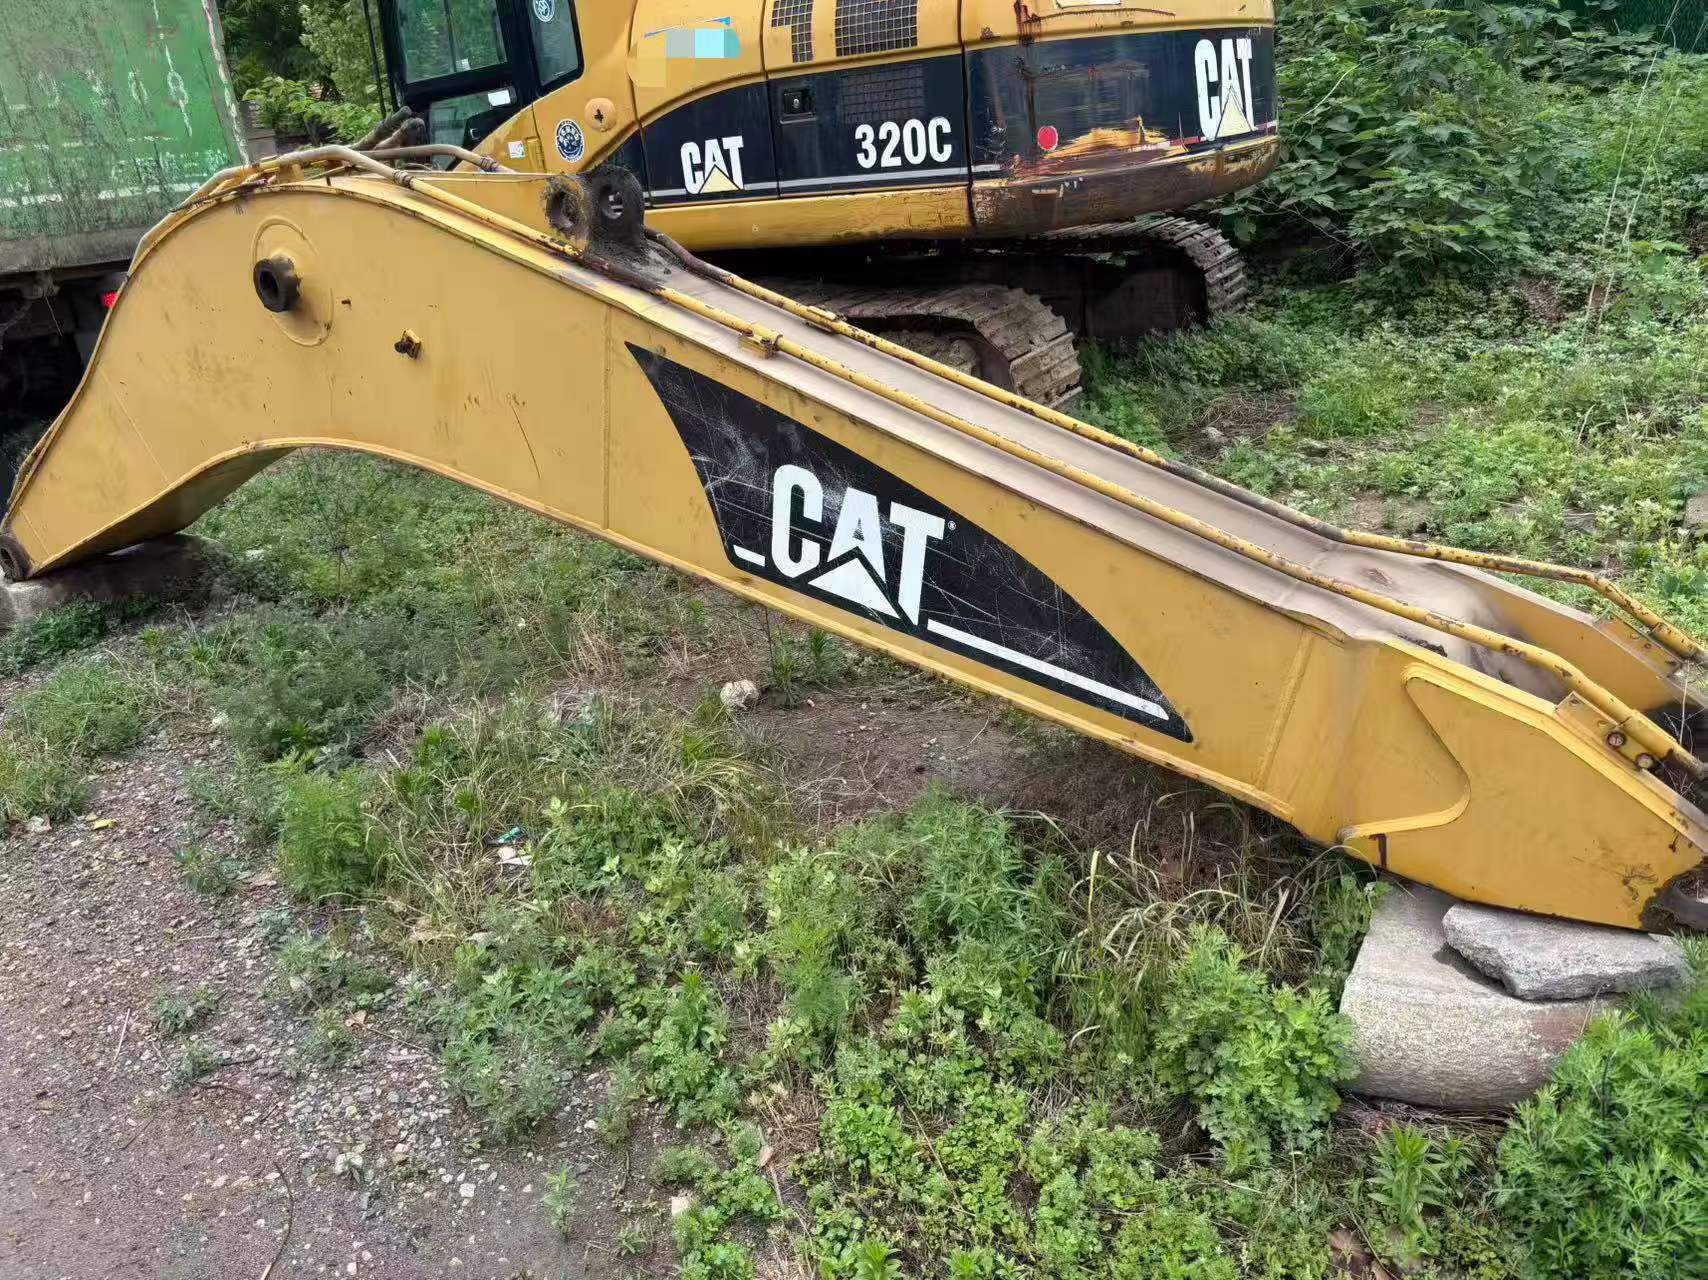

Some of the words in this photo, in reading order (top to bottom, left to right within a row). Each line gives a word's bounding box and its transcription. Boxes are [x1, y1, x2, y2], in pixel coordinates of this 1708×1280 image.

[1194, 38, 1255, 142] CAT
[680, 135, 744, 194] CAT
[854, 116, 952, 168] 320C
[772, 464, 946, 626] CAT
